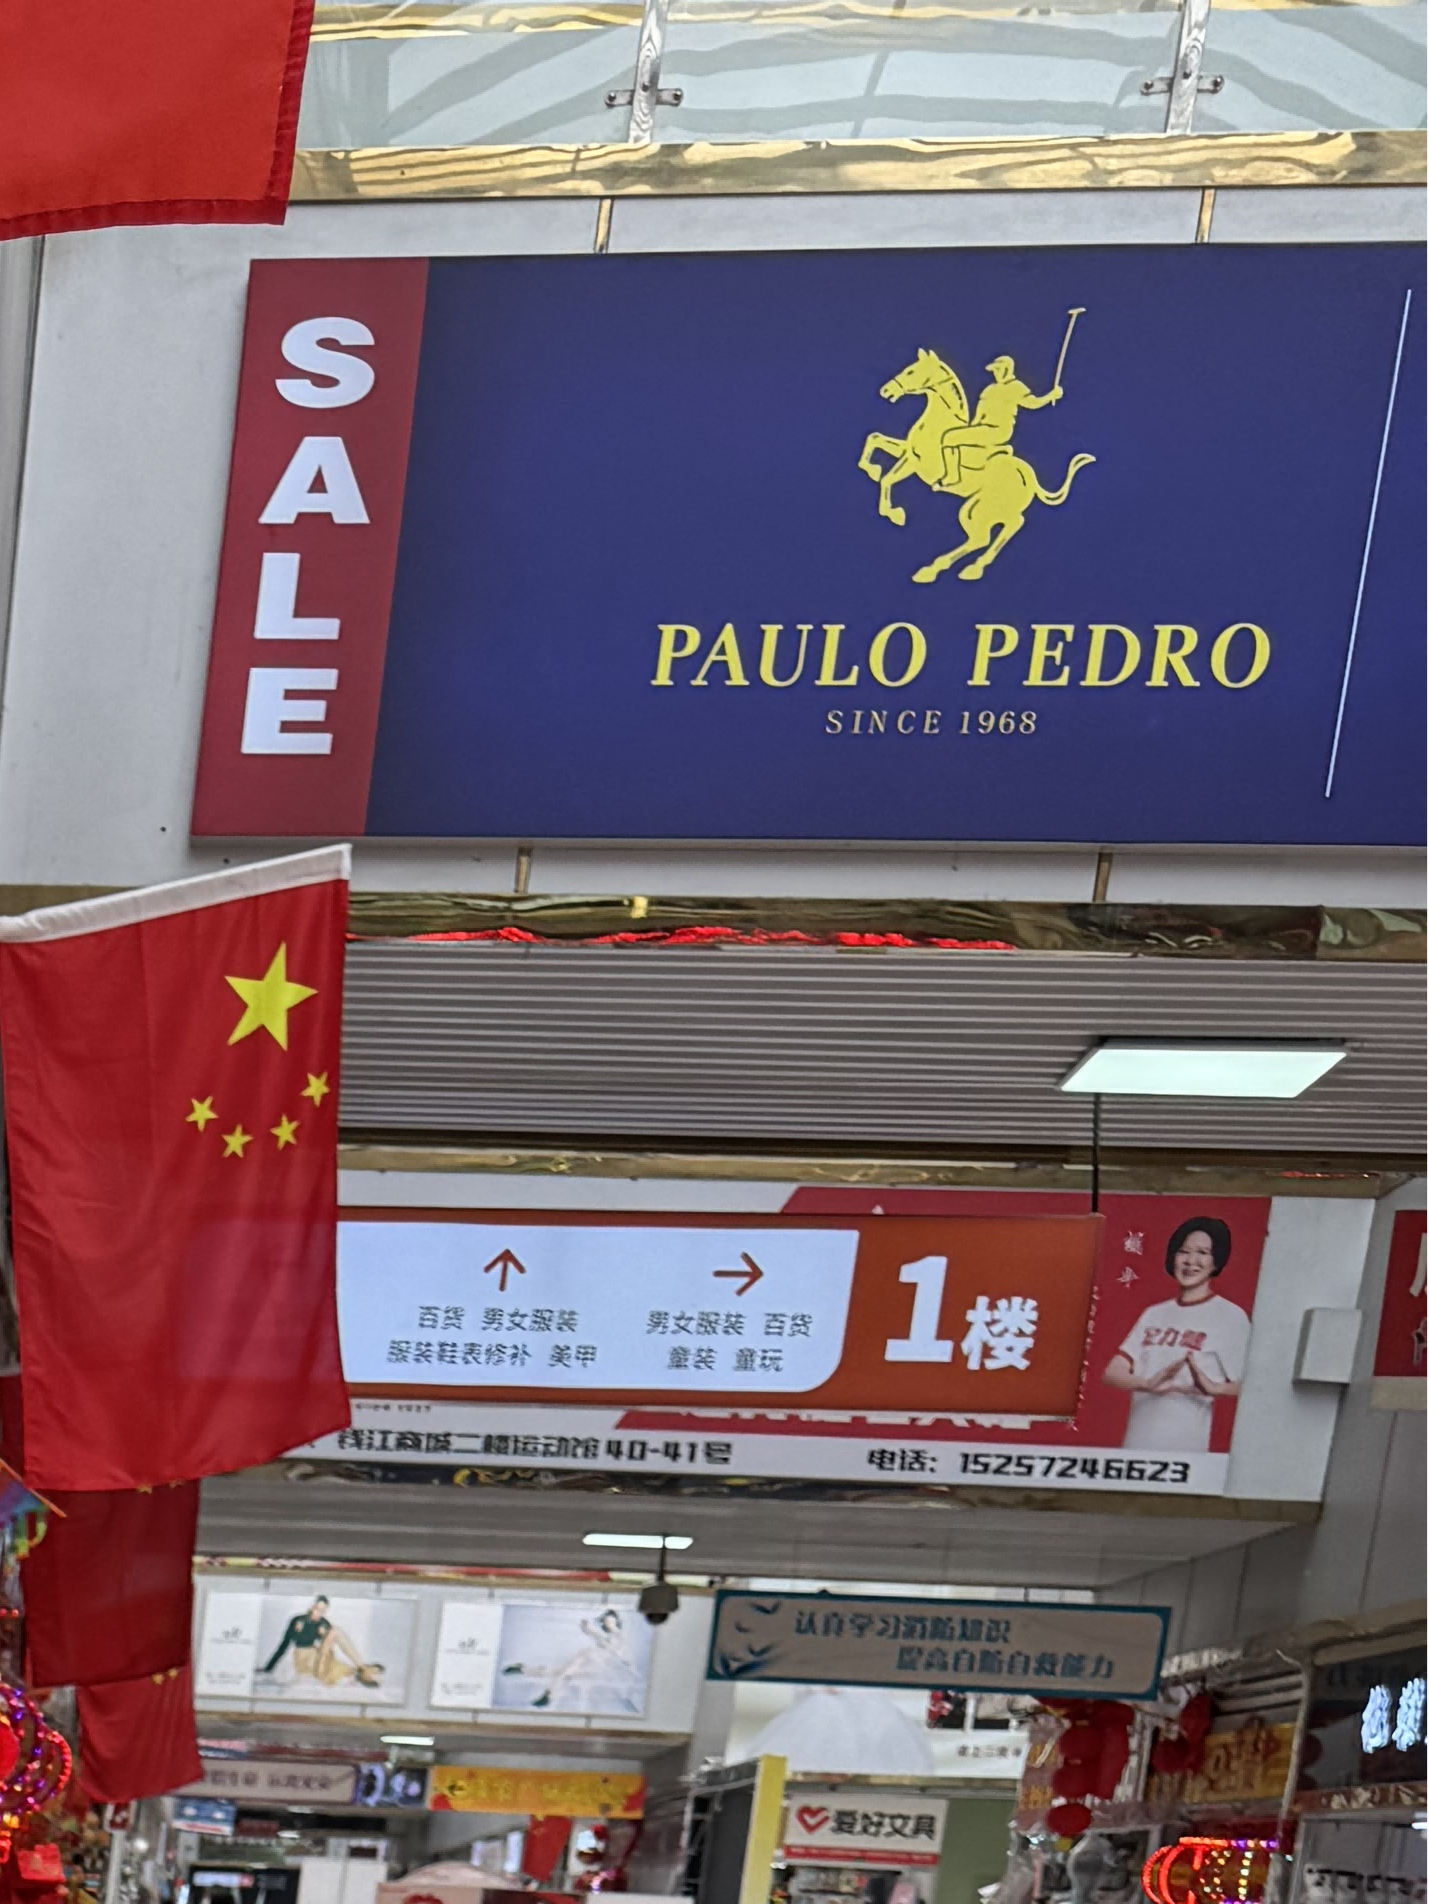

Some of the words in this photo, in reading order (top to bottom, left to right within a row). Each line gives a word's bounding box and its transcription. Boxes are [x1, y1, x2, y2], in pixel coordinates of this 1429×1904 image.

[241, 316, 377, 757] SALE
[649, 620, 928, 689] PAULO
[967, 620, 1273, 690] PEDRO
[825, 709, 943, 737] SINCE
[958, 709, 1039, 737] 1968
[418, 1305, 465, 1331] 百货
[481, 1307, 579, 1333] 男女服装
[645, 1310, 747, 1336] 男女服装
[763, 1312, 814, 1338] 百货
[884, 1254, 1039, 1371] 1楼
[548, 1342, 598, 1369] 美甲
[667, 1345, 718, 1371] 童装
[831, 1809, 937, 1841] 爱好文具
